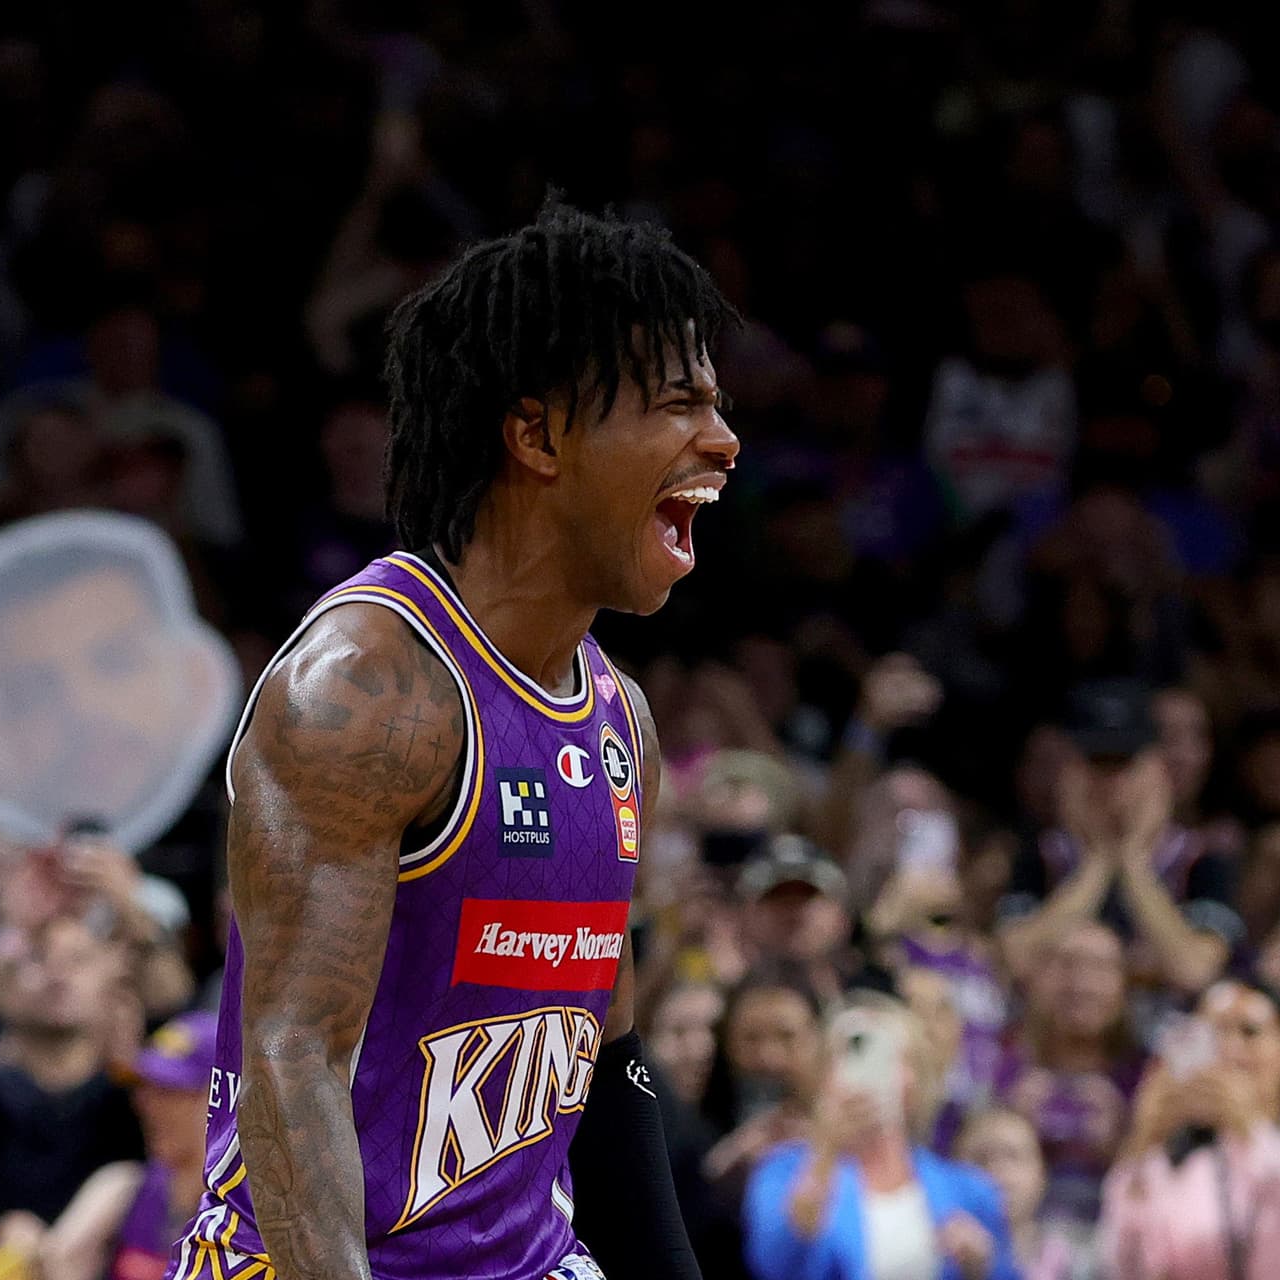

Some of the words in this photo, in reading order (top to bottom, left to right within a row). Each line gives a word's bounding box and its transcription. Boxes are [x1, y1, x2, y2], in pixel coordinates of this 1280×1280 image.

[503, 831, 550, 844] HOSTPLUS
[474, 922, 573, 968] Harvey
[570, 926, 625, 961] Norma
[396, 1006, 604, 1226] KING
